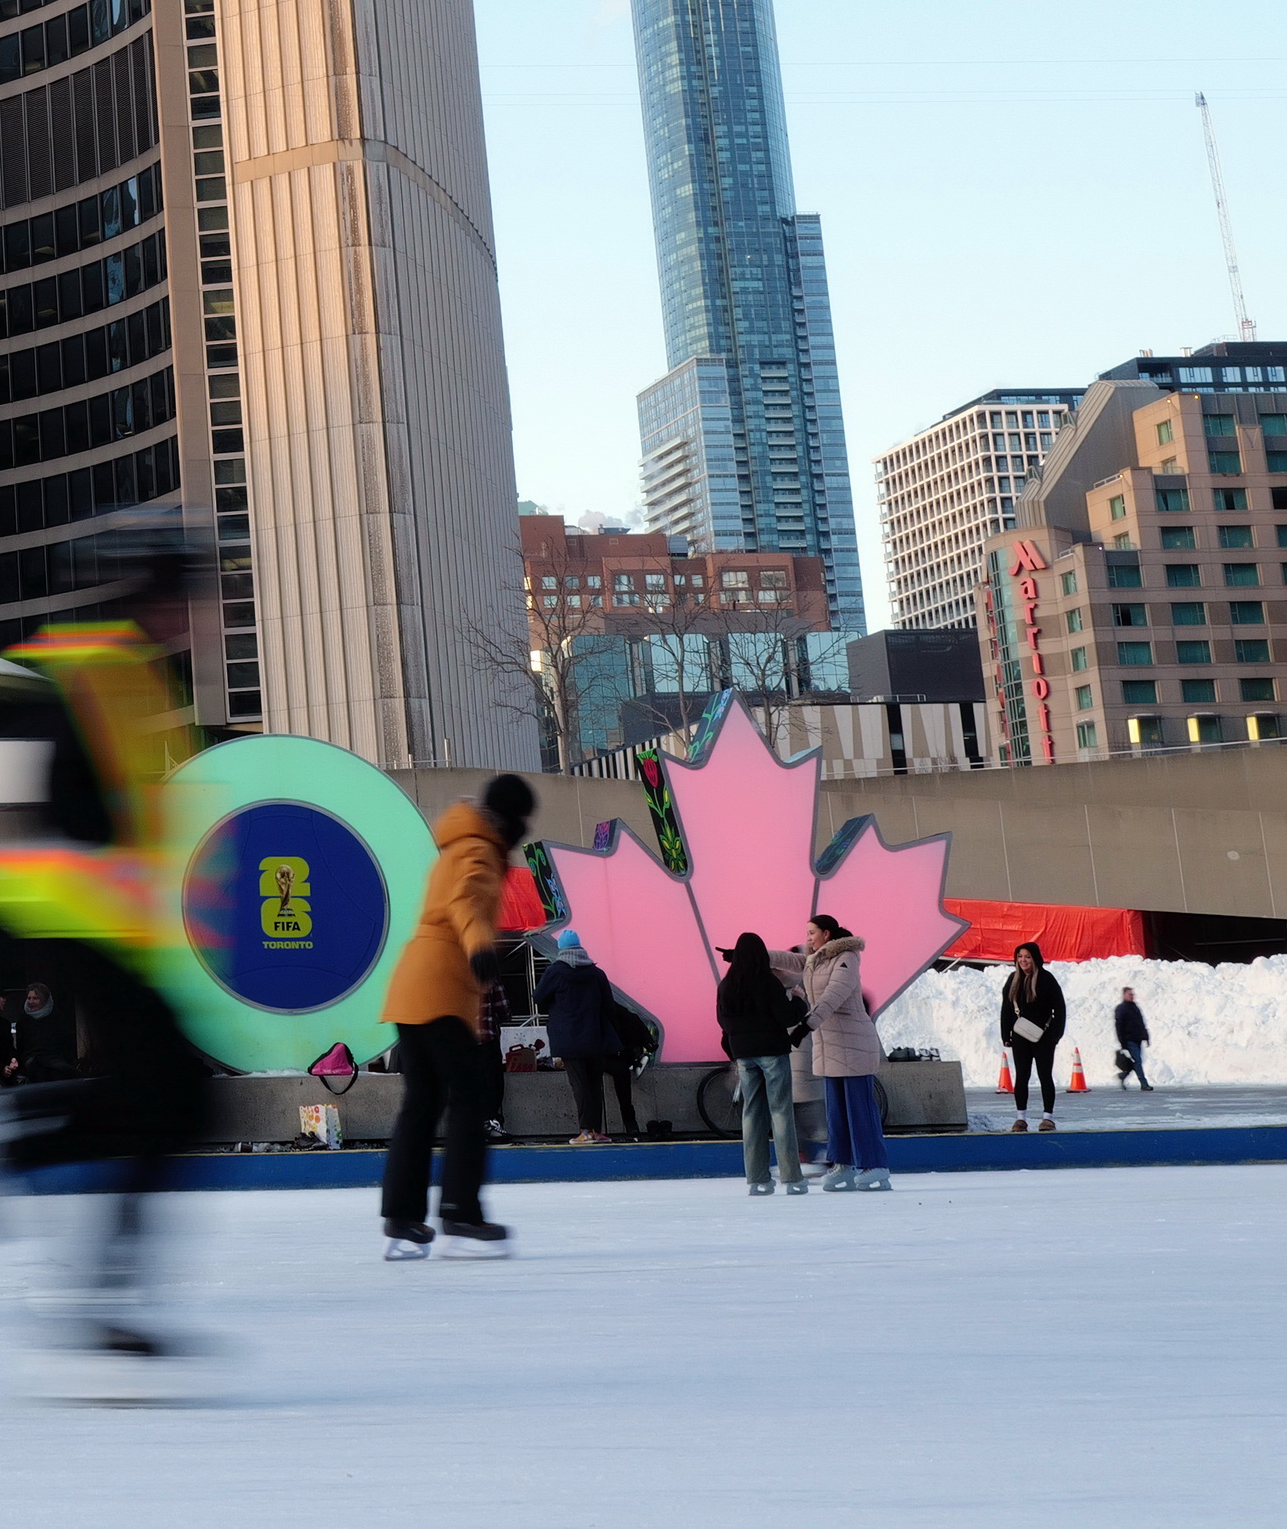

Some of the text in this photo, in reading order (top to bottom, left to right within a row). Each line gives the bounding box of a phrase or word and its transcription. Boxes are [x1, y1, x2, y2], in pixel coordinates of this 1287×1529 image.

[1008, 539, 1056, 764] Marriott
[274, 922, 301, 931] FIFA
[262, 941, 314, 949] TORONTO
